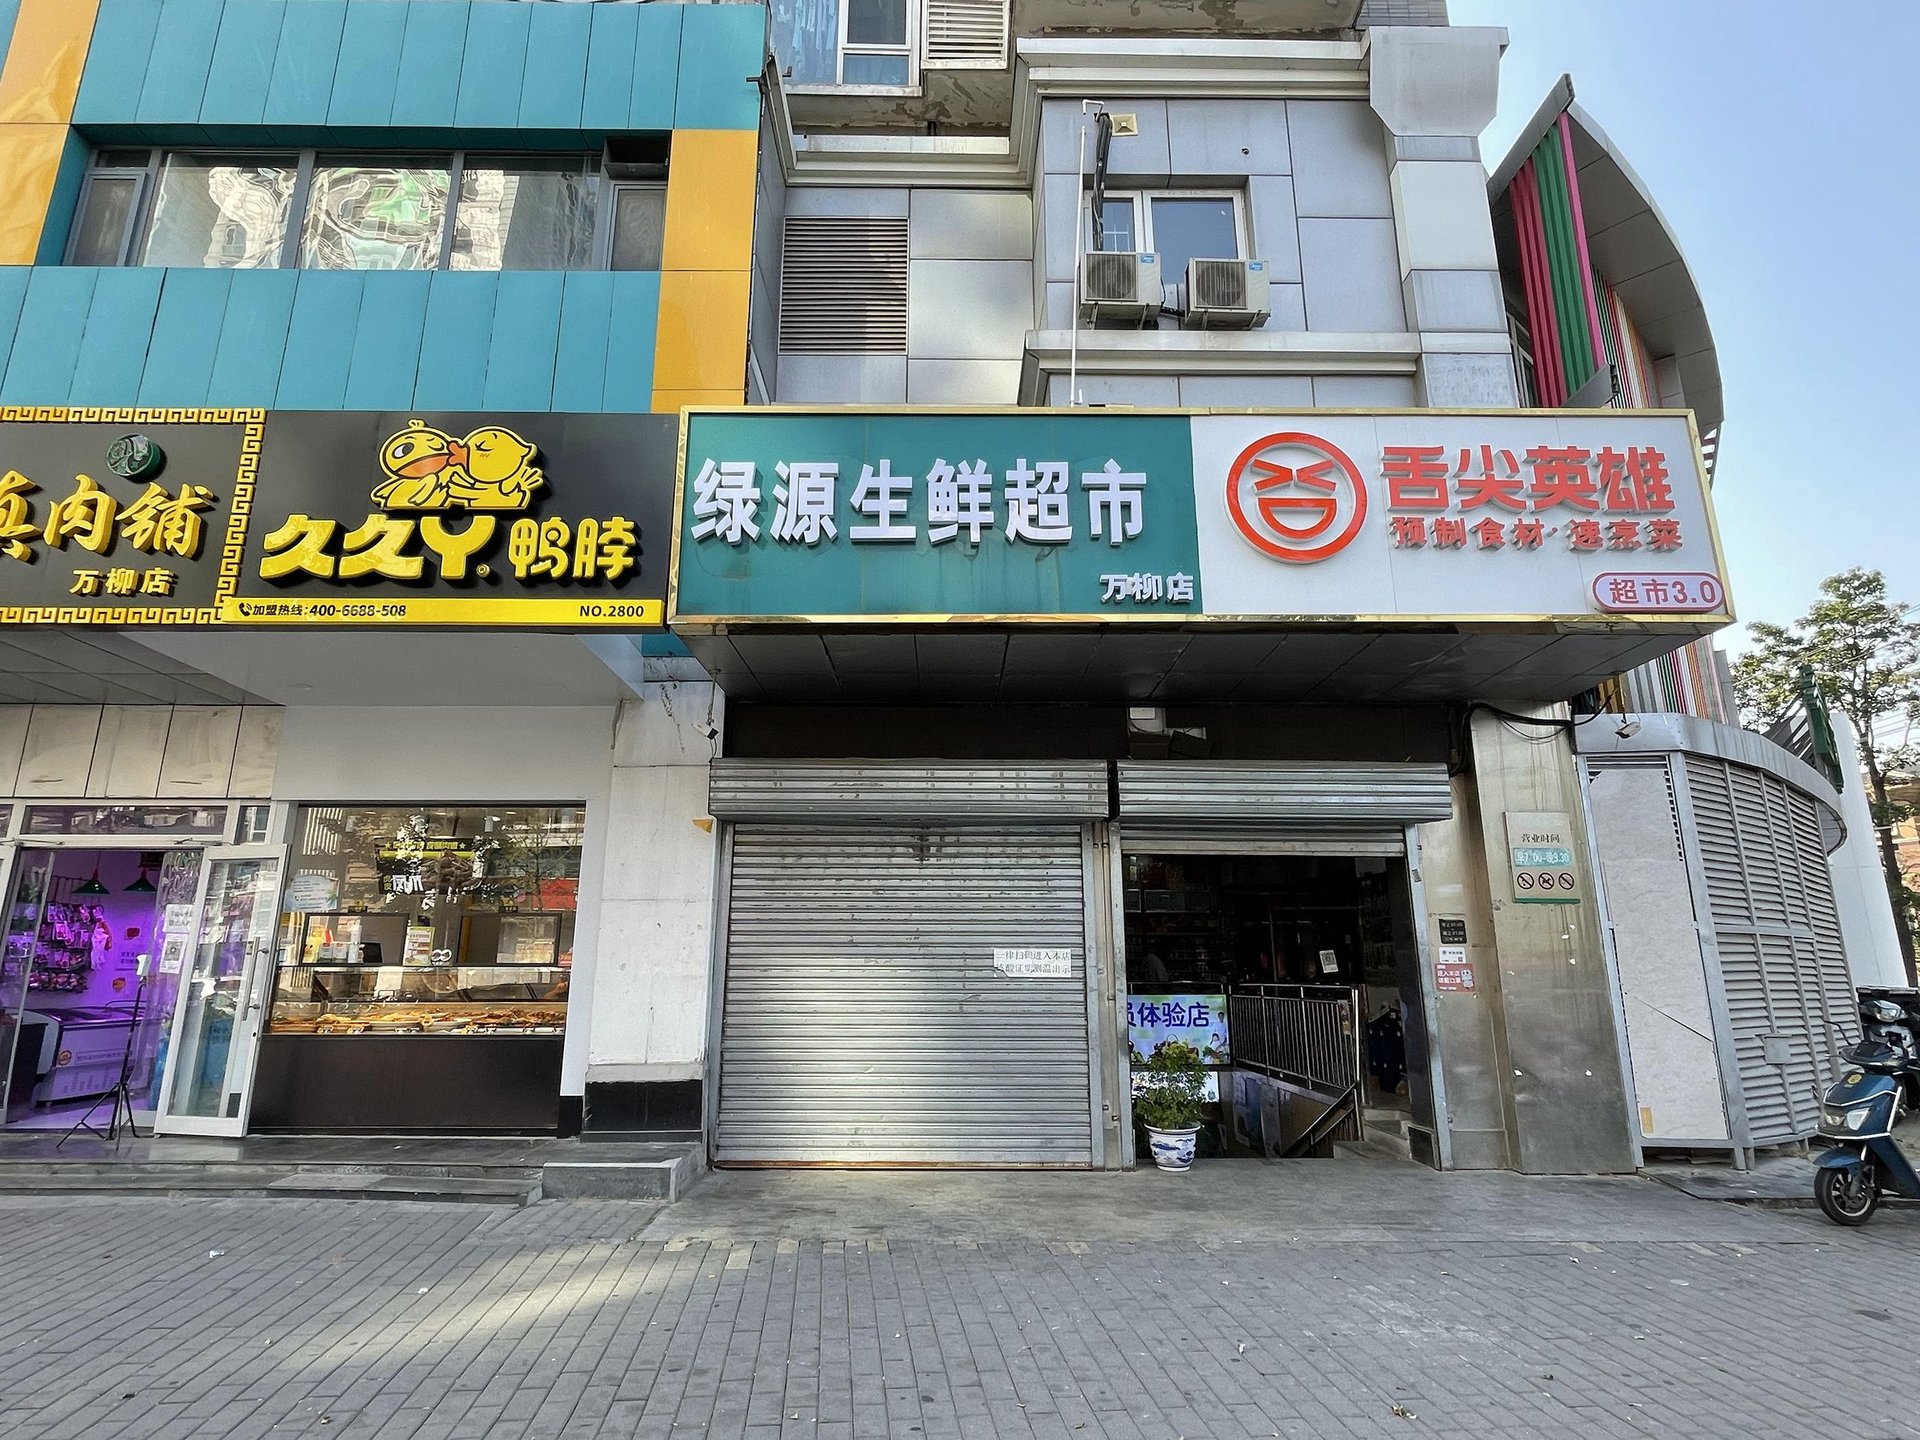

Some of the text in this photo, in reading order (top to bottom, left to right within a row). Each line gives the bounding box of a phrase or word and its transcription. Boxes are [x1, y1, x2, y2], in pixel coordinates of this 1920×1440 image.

[1382, 443, 1676, 514] 舌尖英雄
[691, 457, 1147, 547] 绿源生鲜超市
[508, 516, 638, 581] 鸭脖
[70, 567, 173, 597] 万柳店
[1101, 573, 1195, 604] 万柳店
[1609, 577, 1717, 606] 超市3.0
[579, 604, 645, 617] NO.2800
